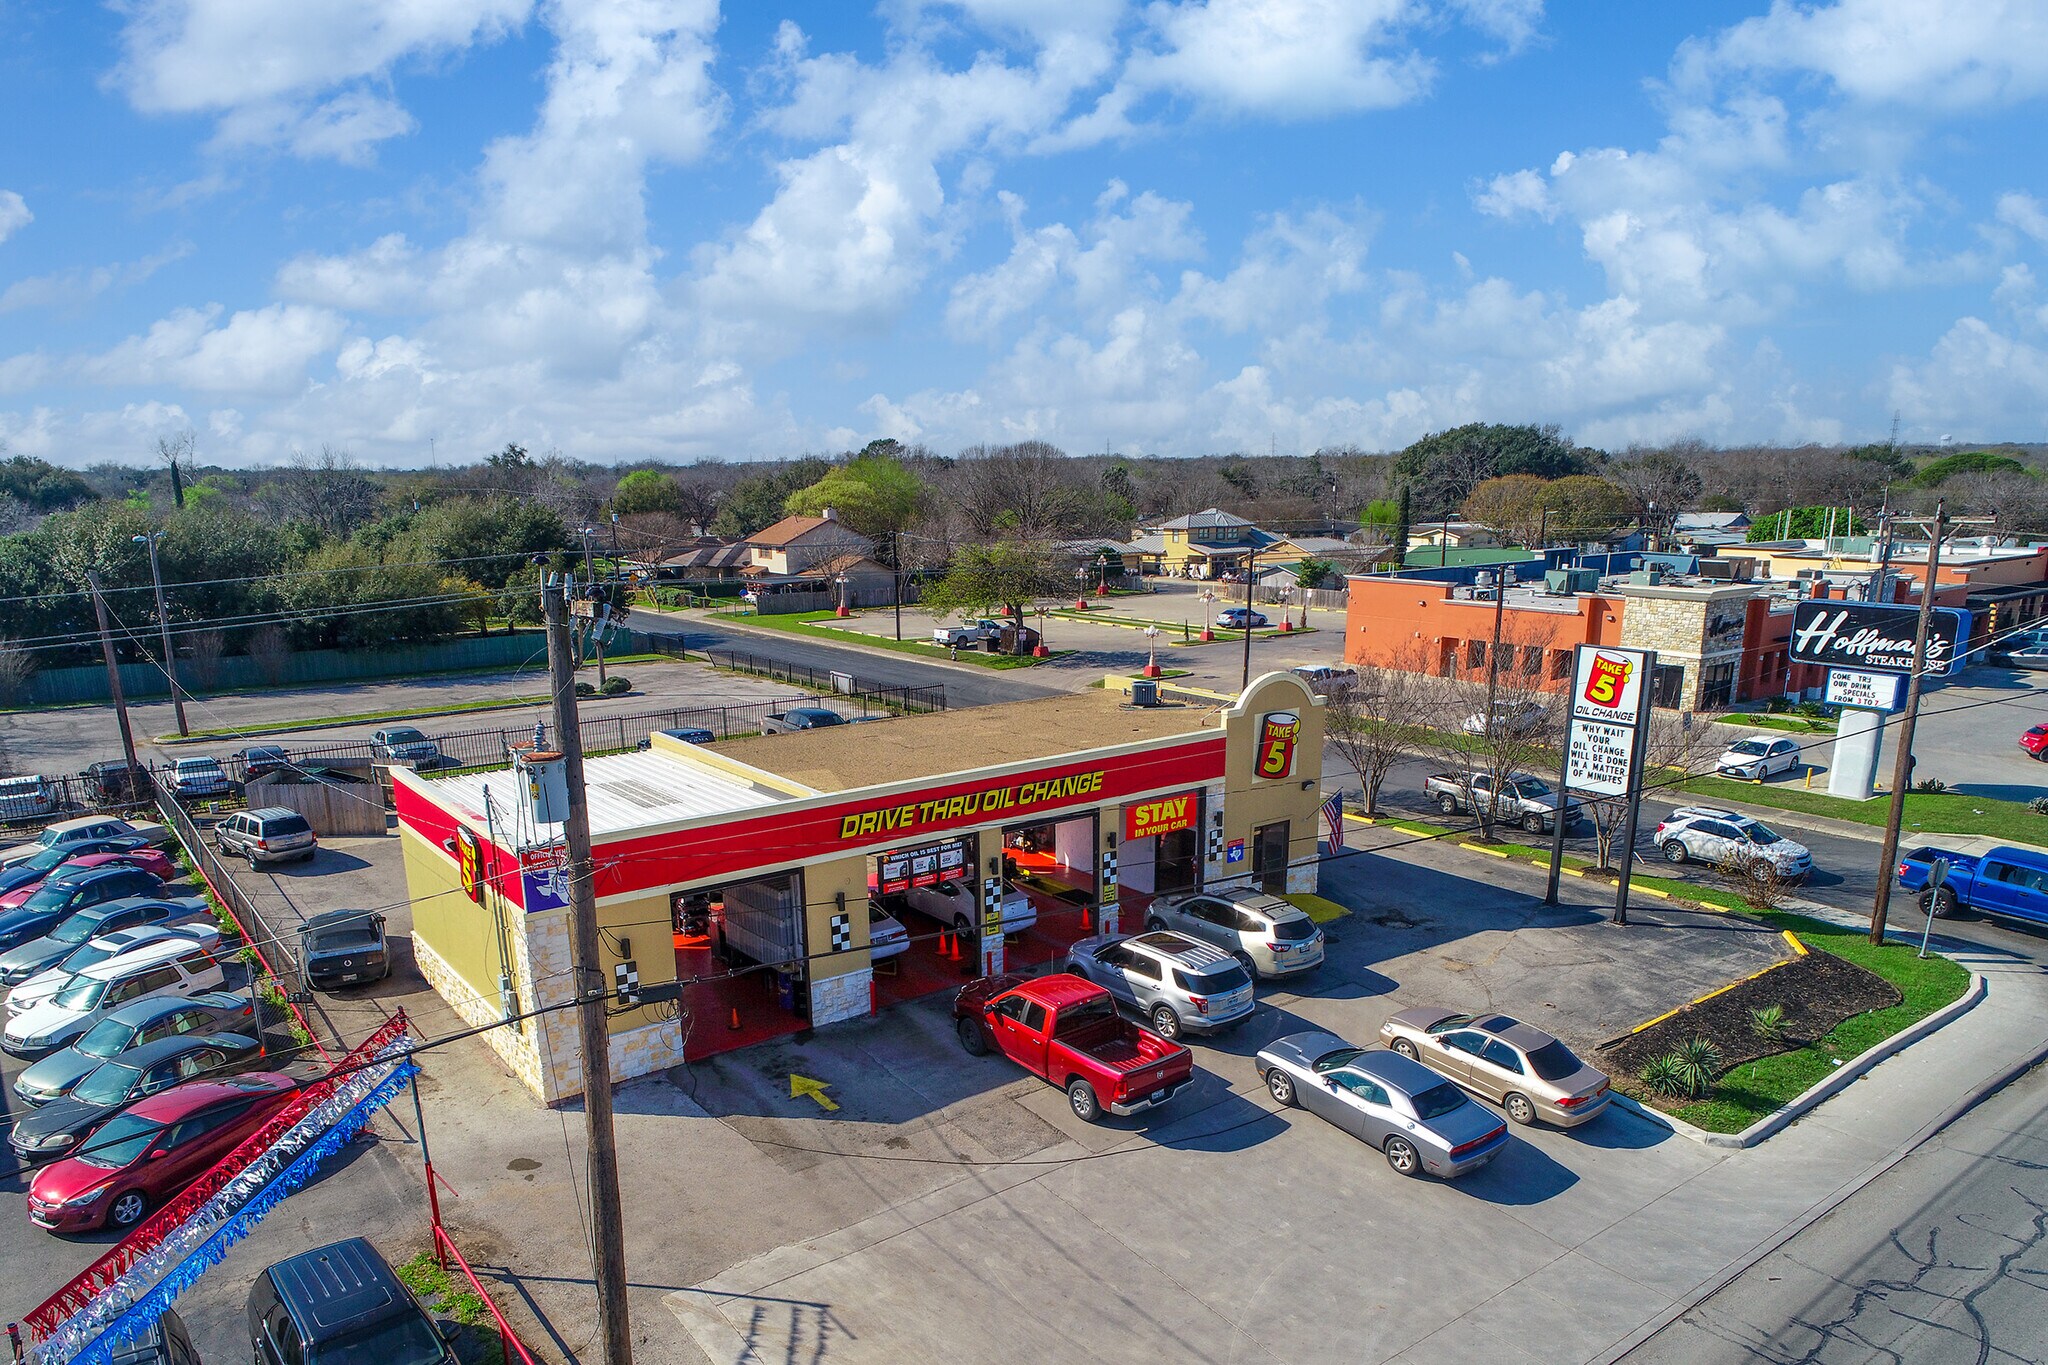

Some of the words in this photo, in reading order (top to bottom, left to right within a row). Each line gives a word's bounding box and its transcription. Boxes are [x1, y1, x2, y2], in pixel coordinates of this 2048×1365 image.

[1596, 657, 1623, 676] TAKE
[1865, 654, 1945, 671] STEAKHUSE
[1832, 673, 1851, 681] COME
[1833, 680, 1848, 688] OUR
[1850, 682, 1872, 690] DRINK
[1590, 673, 1616, 702] 5
[1843, 689, 1876, 699] SPECIALS
[1834, 695, 1853, 703] FROM
[1864, 698, 1873, 706] TO
[1575, 705, 1590, 715] OIL
[1592, 708, 1635, 722] CHANGE
[1267, 723, 1291, 738] TAKE
[1582, 724, 1600, 734] WHY
[1603, 728, 1625, 738] WAIT
[1587, 734, 1610, 745] YOUR
[1264, 741, 1286, 773] 5
[1573, 741, 1588, 751] OIL
[1592, 744, 1625, 757] CHANGE
[1571, 750, 1590, 760] WILL
[1592, 753, 1603, 763] BE
[1606, 756, 1628, 767] DONE
[1571, 759, 1579, 767] IN
[1582, 761, 1588, 769] A
[1592, 764, 1625, 776] MATTER
[1573, 768, 1584, 777] OF
[1587, 771, 1623, 785] MINUTES
[840, 804, 916, 839] DRIVE
[919, 793, 981, 824] THRU
[982, 787, 1015, 812] OIL
[1018, 770, 1105, 805] CHANGE
[1135, 796, 1188, 826] STAY
[1134, 828, 1145, 838] IN
[1146, 823, 1169, 835] YOUR
[1170, 819, 1188, 830] CAR
[890, 853, 909, 861] WHICH
[910, 850, 919, 858] OIL
[920, 848, 926, 856] IS
[927, 846, 940, 854] BEST
[462, 856, 473, 893] 5
